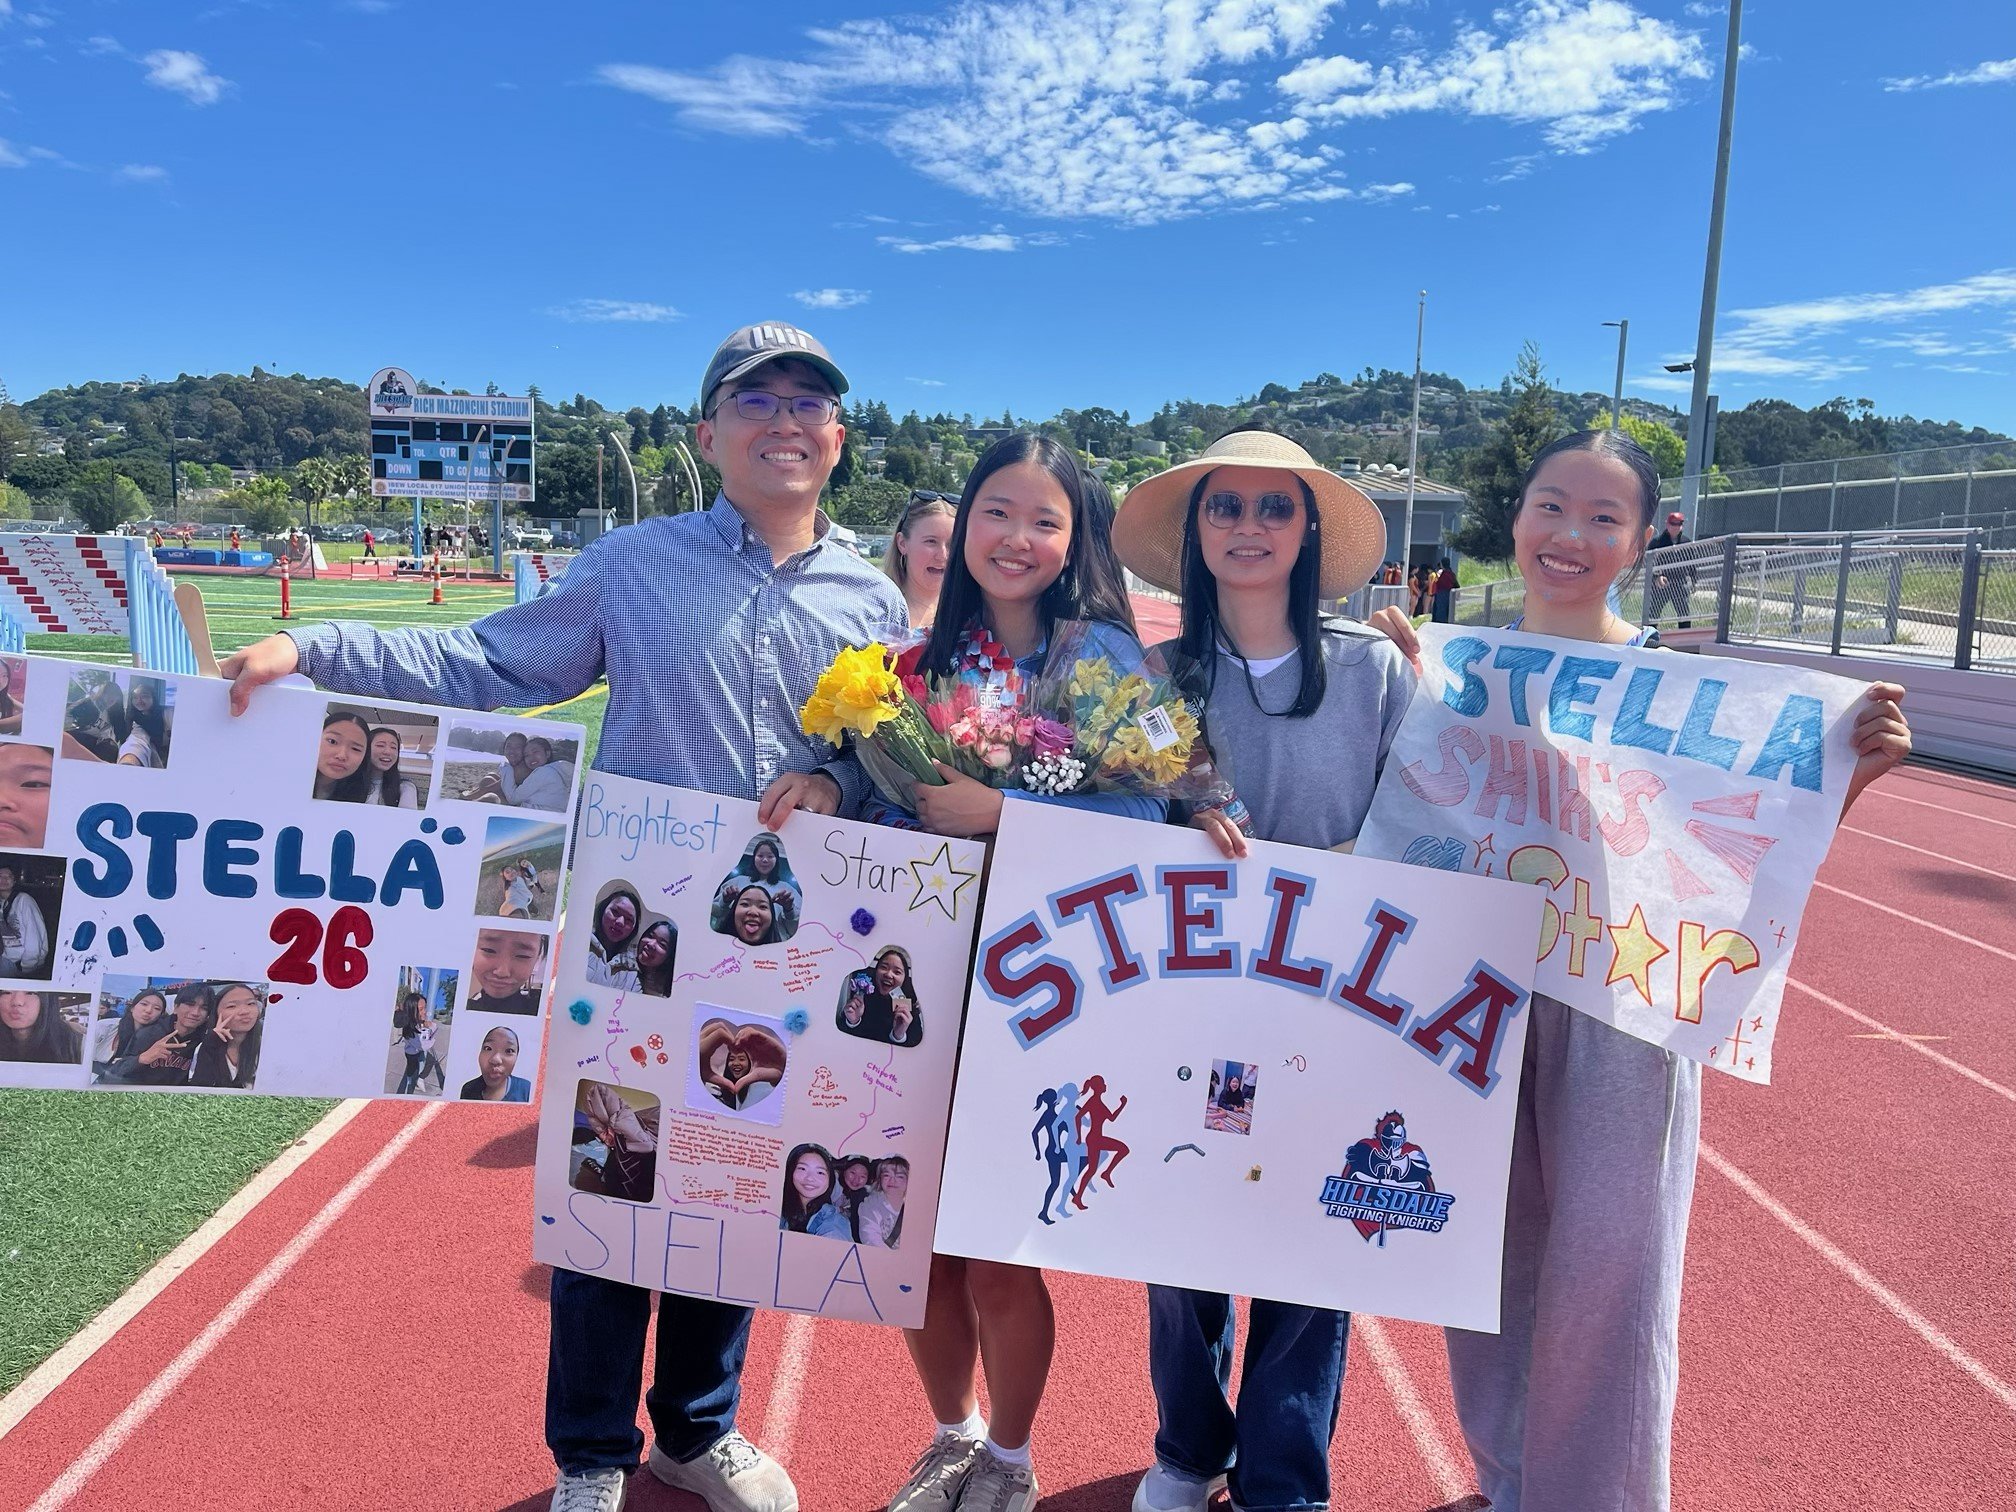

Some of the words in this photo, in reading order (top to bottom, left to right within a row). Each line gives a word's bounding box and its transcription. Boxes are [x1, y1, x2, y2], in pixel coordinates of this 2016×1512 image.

[414, 398, 434, 413] RICH
[437, 399, 488, 415] MAZZONCINI
[491, 400, 529, 417] STADIUM
[413, 449, 425, 457] TOL
[439, 447, 456, 458] QTR
[388, 464, 411, 474] DOWN
[444, 466, 454, 476] TO
[457, 466, 467, 476] GO
[1442, 637, 1825, 793] STELLA
[586, 784, 727, 861] Brightest
[73, 803, 443, 909] STELLA
[821, 830, 907, 893] Star
[267, 906, 374, 989] 26
[976, 863, 1530, 1099] STELLA
[862, 1071, 874, 1085] big
[875, 1079, 894, 1092] back
[866, 1062, 898, 1083] Chipotle
[713, 1201, 739, 1213] lovely
[1322, 1180, 1452, 1218] HILLSDALE
[1328, 1204, 1384, 1223] FIGHTING
[1388, 1213, 1442, 1232] KNIGHTS
[565, 1192, 883, 1321] STELLA
